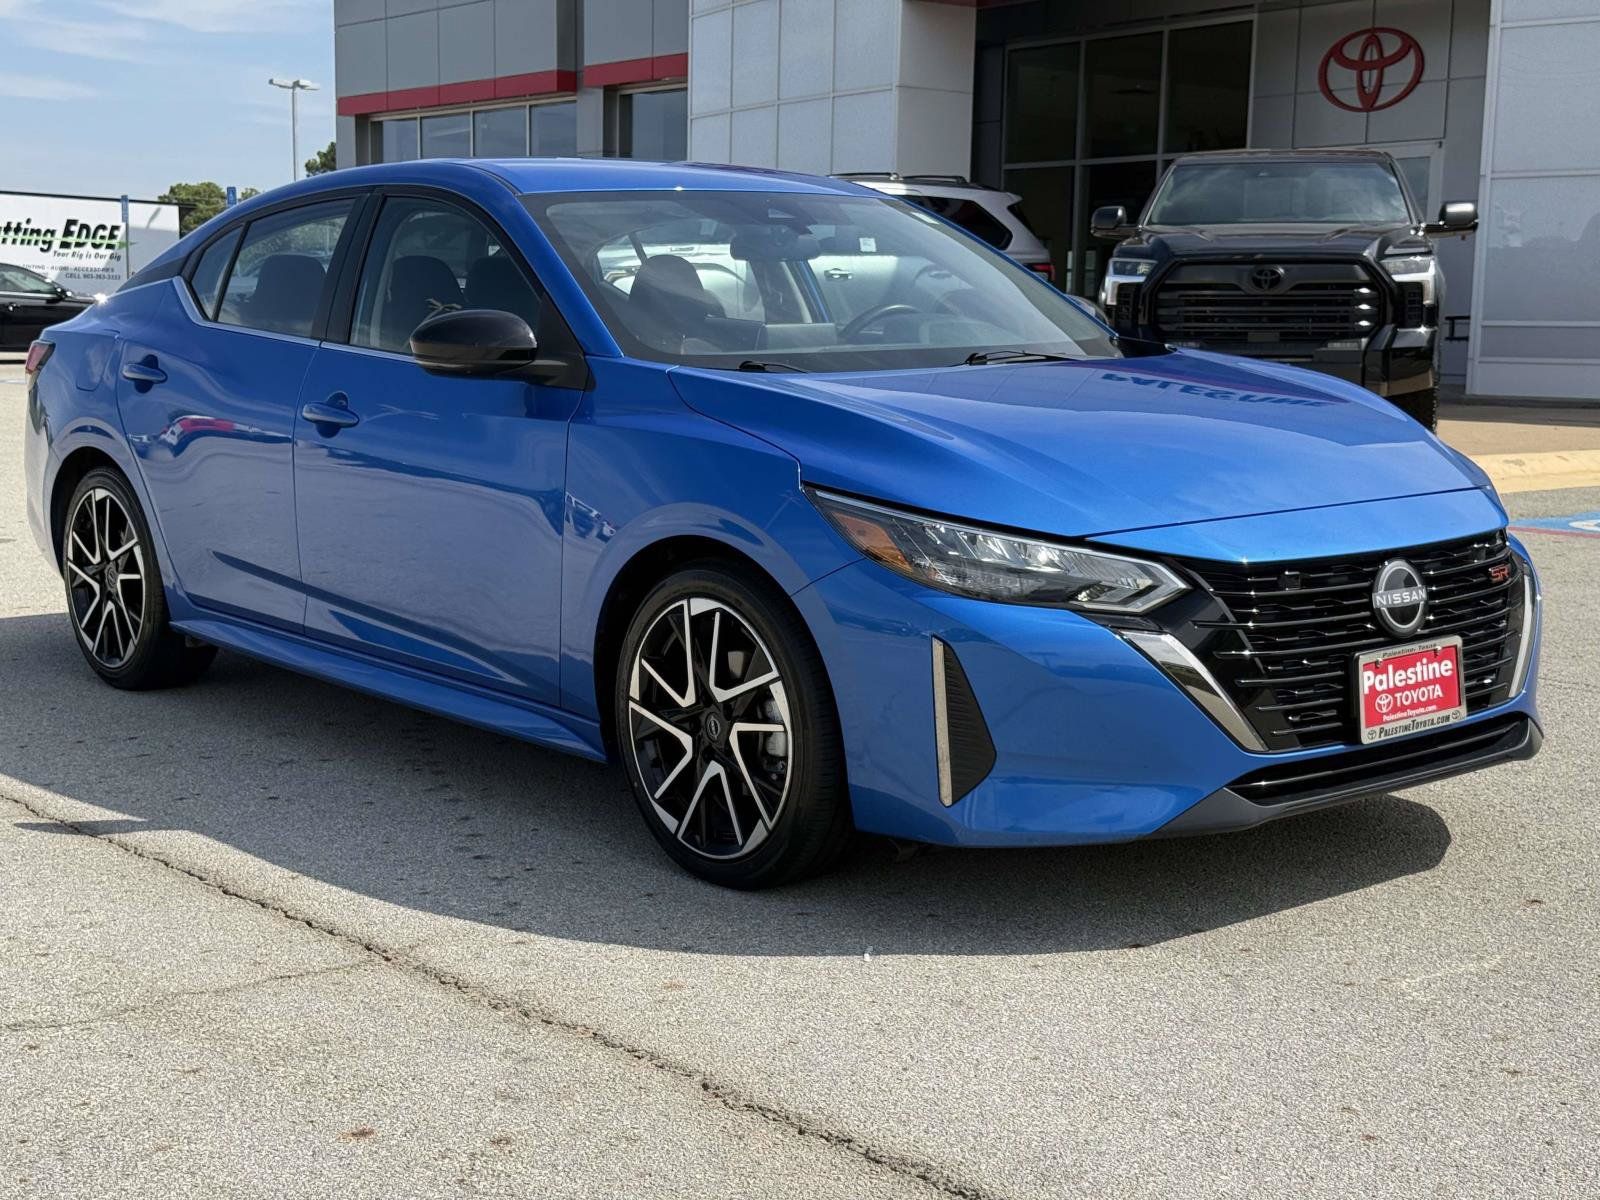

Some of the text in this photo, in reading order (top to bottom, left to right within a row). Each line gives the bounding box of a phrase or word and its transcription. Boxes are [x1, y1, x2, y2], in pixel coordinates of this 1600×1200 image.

[0, 218, 121, 253] tting EDGE
[1490, 566, 1509, 581] SR
[1376, 588, 1426, 606] NISSAN
[1363, 658, 1453, 695] Palestine
[1394, 684, 1444, 707] TOYOTA
[1382, 704, 1438, 722] PalestineToyota.com
